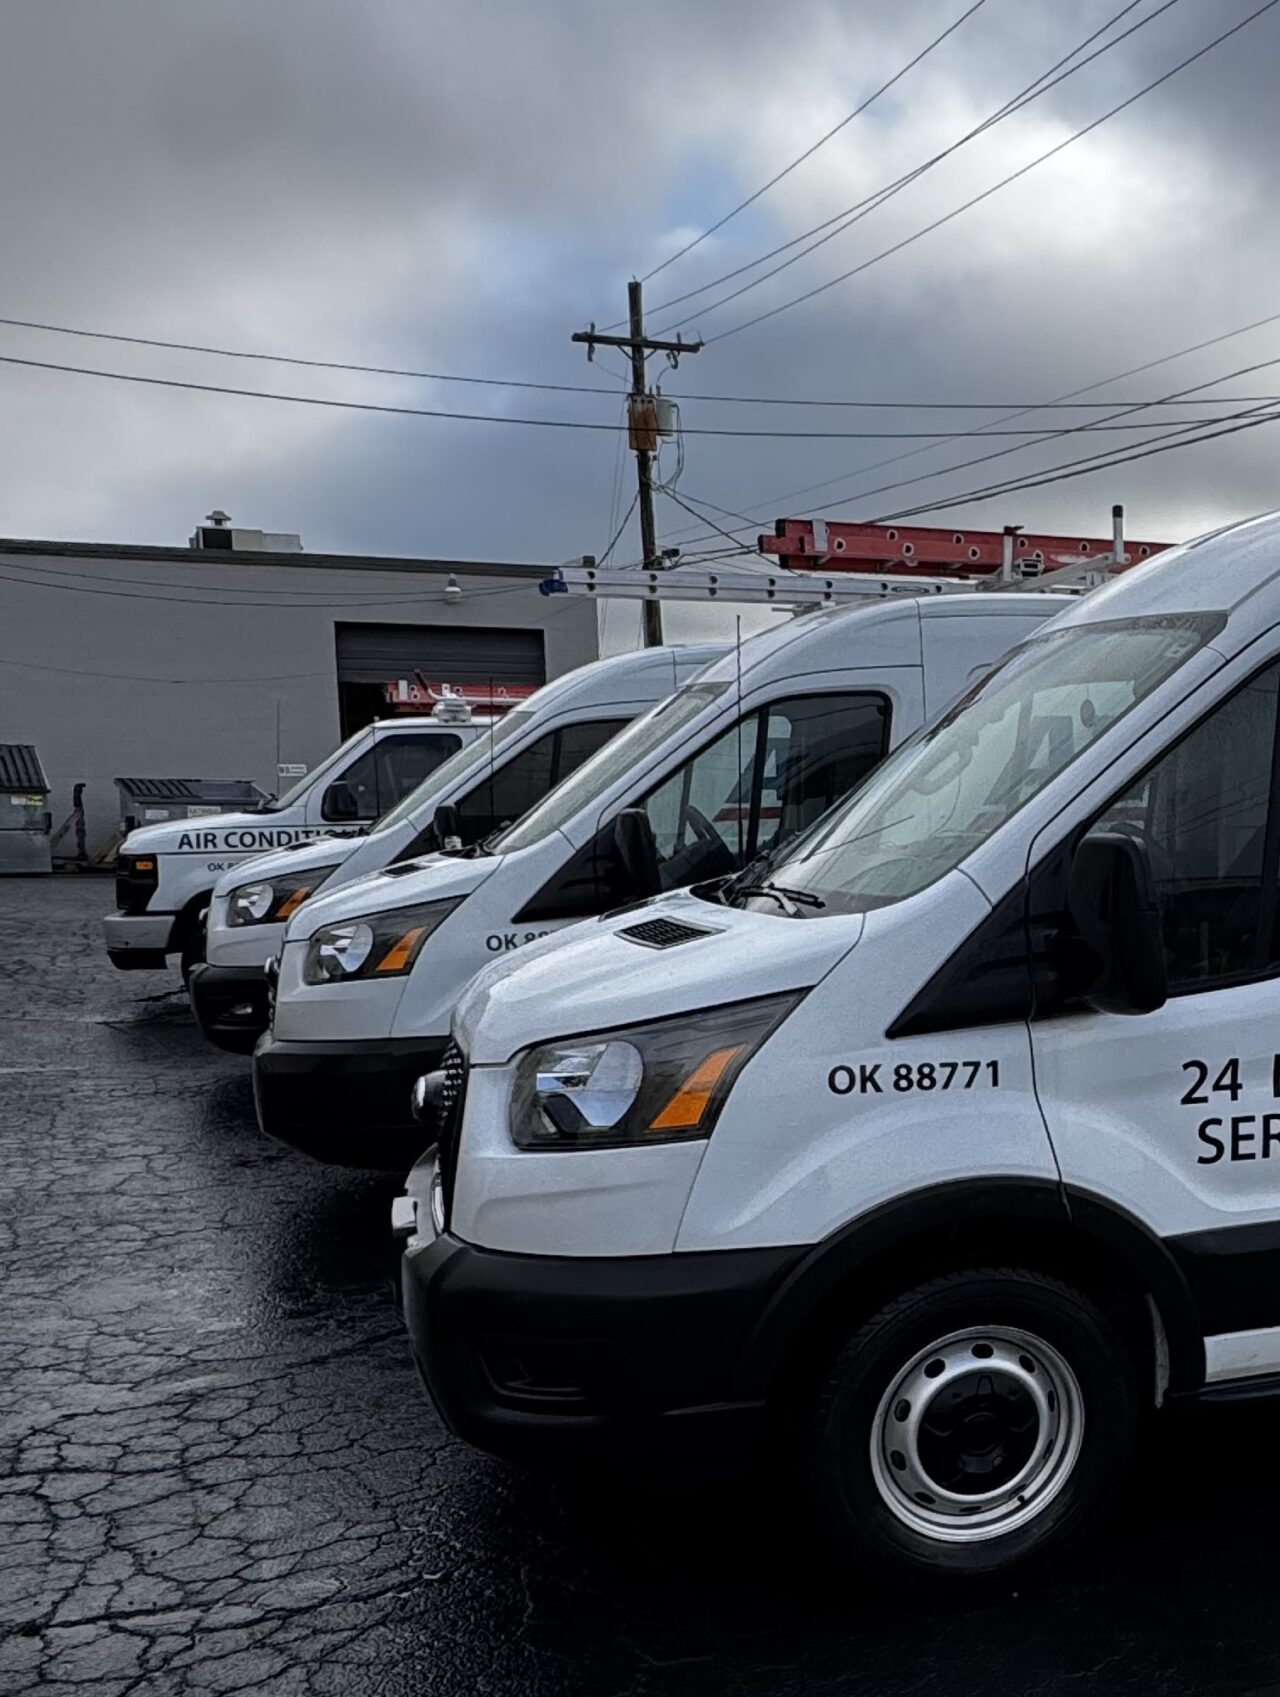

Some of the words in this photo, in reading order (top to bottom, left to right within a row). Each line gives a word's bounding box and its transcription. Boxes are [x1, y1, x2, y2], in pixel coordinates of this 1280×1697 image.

[178, 832, 217, 849] AIR
[207, 862, 225, 872] OK
[485, 933, 518, 952] OK
[827, 1064, 883, 1095] OK
[892, 1060, 1000, 1092] 88771
[1180, 1058, 1243, 1105] 24
